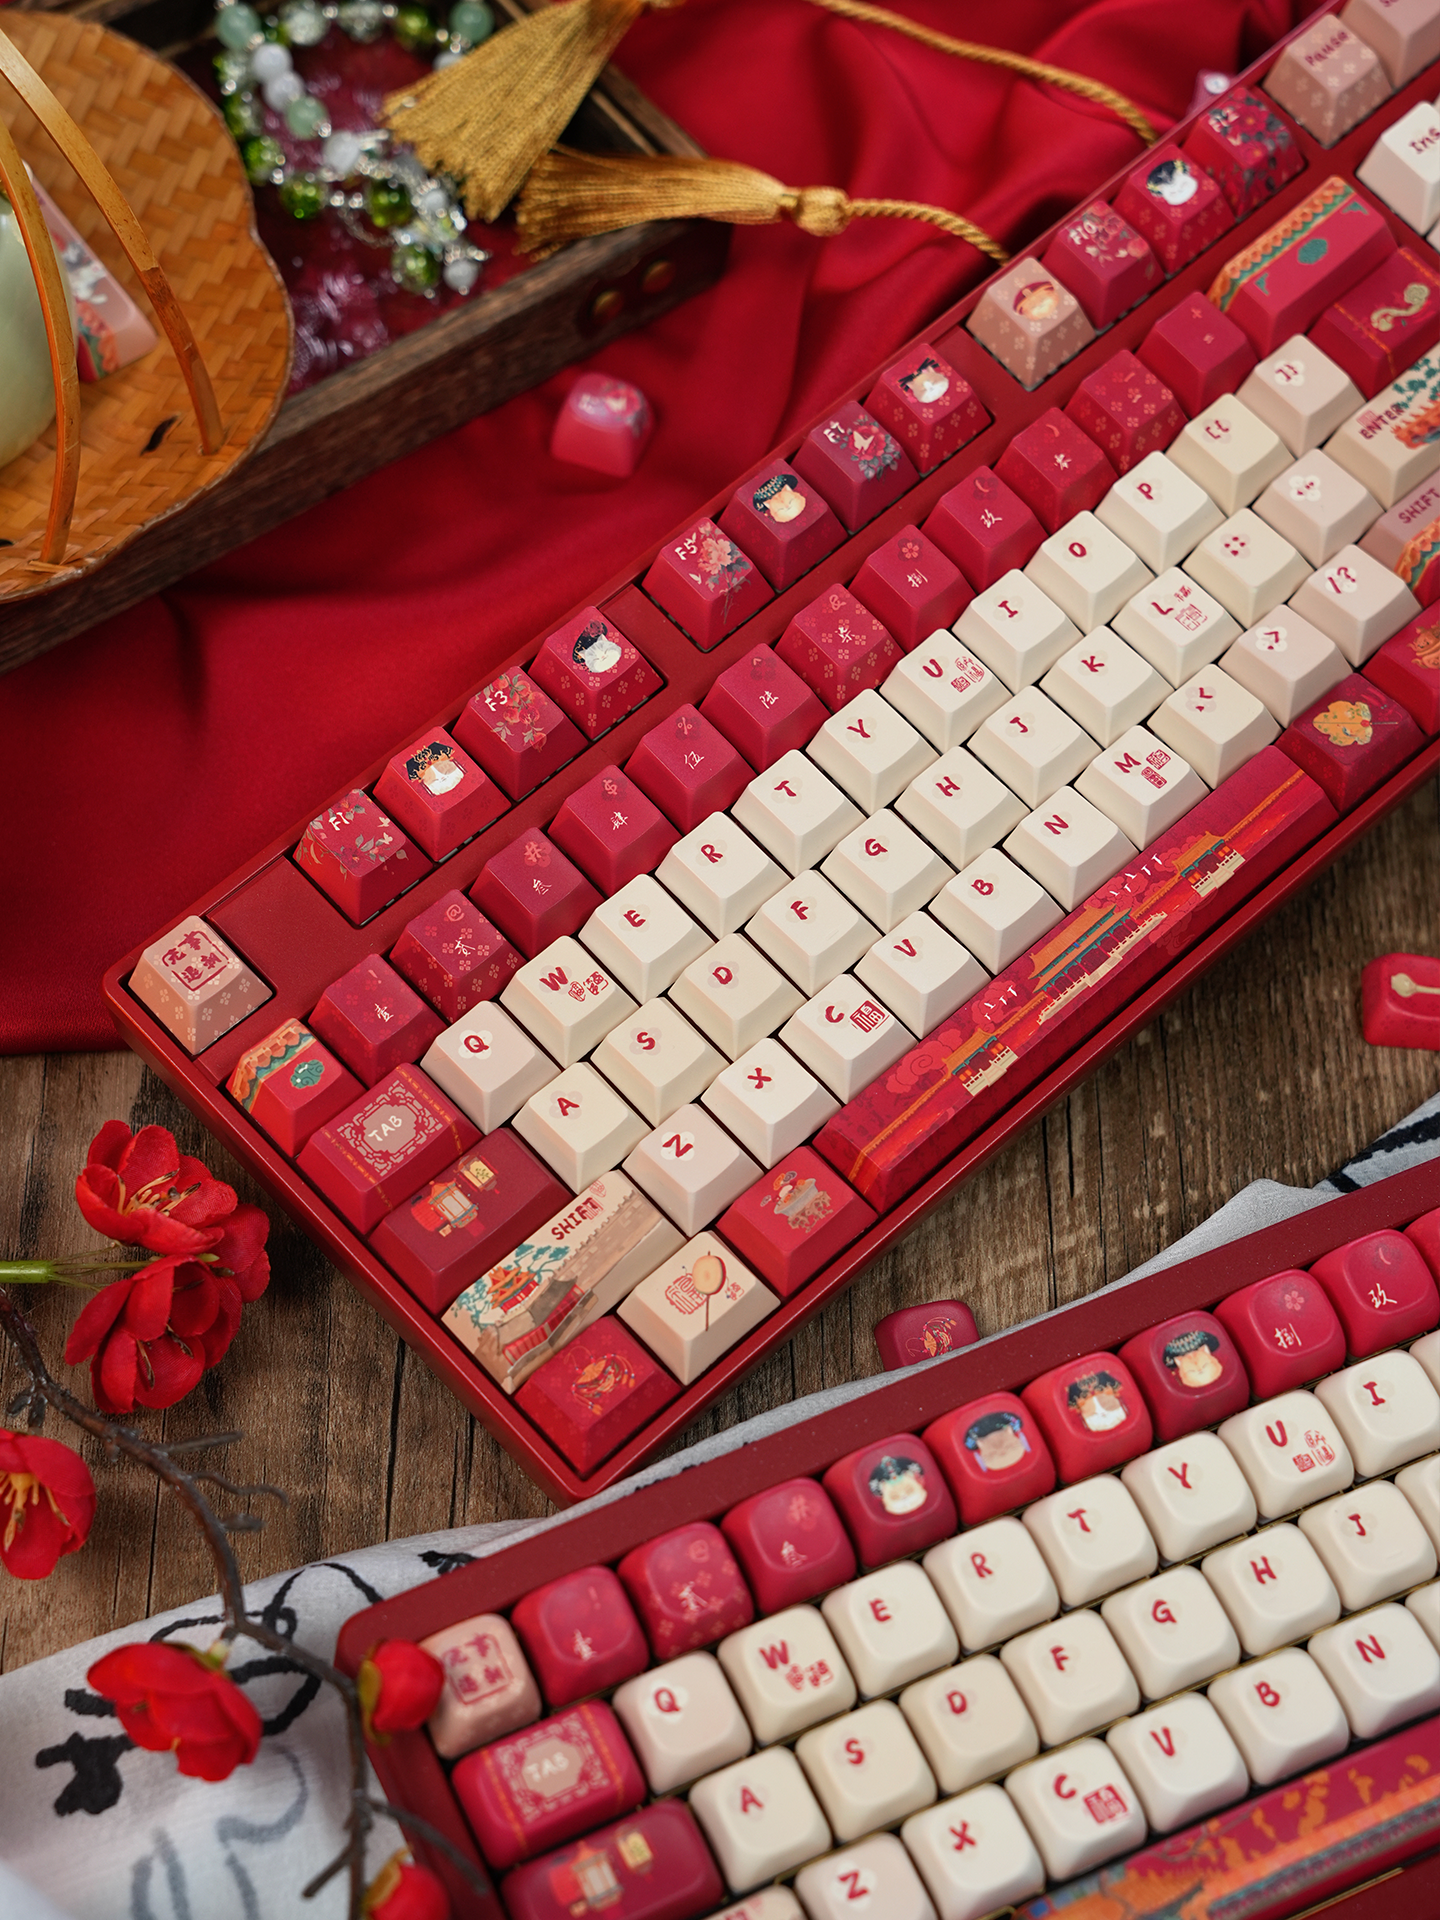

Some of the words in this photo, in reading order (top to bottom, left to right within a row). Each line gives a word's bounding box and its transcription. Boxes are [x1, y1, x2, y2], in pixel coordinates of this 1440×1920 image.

[1305, 31, 1348, 66] Pause
[1069, 219, 1098, 245] F10
[823, 421, 845, 443] F7
[1359, 403, 1405, 440] ENTER
[1137, 483, 1153, 499] P
[1398, 487, 1440, 524] SHIFT
[980, 509, 1002, 528] 玖
[674, 541, 698, 561] F5
[1069, 542, 1086, 557] O
[829, 594, 847, 610] &
[999, 600, 1018, 617] I
[1151, 602, 1173, 615] L
[923, 659, 943, 677] U
[1081, 656, 1104, 672] K
[484, 690, 508, 712] F3
[759, 691, 779, 709] 陆
[677, 717, 692, 735] %
[847, 719, 870, 738] Y
[1010, 717, 1028, 732] J
[684, 751, 704, 769] 伍
[1114, 753, 1141, 773] M
[602, 778, 618, 795] $
[774, 780, 796, 796] T
[936, 776, 960, 796] H
[328, 812, 350, 831] F1
[1044, 815, 1069, 834] N
[524, 841, 542, 862] #
[701, 844, 723, 863] R
[865, 839, 887, 856] G
[971, 879, 993, 895] B
[446, 904, 465, 921] @
[624, 910, 646, 927] E
[791, 901, 808, 920] F
[894, 939, 917, 957] V
[539, 967, 568, 991] W
[713, 967, 732, 984] D
[375, 1003, 394, 1023] 壹
[825, 1006, 844, 1023] C
[850, 1000, 886, 1033] 福
[464, 1035, 489, 1053] Q
[637, 1032, 655, 1050] S
[747, 1067, 772, 1089] X
[557, 1098, 579, 1116] A
[368, 1115, 403, 1143] TAB
[663, 1134, 693, 1157] Z
[551, 1197, 599, 1240] SHIFT
[1367, 1283, 1398, 1309] 玖
[1273, 1322, 1303, 1349] 捌
[1363, 1381, 1385, 1406] I
[1266, 1420, 1288, 1447] U
[1168, 1463, 1191, 1489] Y
[1068, 1509, 1090, 1532] T
[1348, 1514, 1366, 1536] J
[971, 1553, 993, 1578] R
[1251, 1557, 1276, 1584] H
[870, 1600, 891, 1622] E
[1152, 1600, 1176, 1623] G
[760, 1641, 789, 1669] W
[1051, 1647, 1068, 1671] F
[1356, 1635, 1385, 1663] N
[654, 1689, 680, 1713] Q
[947, 1691, 967, 1714] D
[1255, 1682, 1280, 1707] B
[845, 1739, 864, 1765] S
[1151, 1728, 1175, 1756] V
[526, 1751, 570, 1783] TAB
[1054, 1775, 1076, 1799] C
[741, 1787, 763, 1813] A
[950, 1822, 976, 1851] X
[839, 1871, 868, 1899] Z
